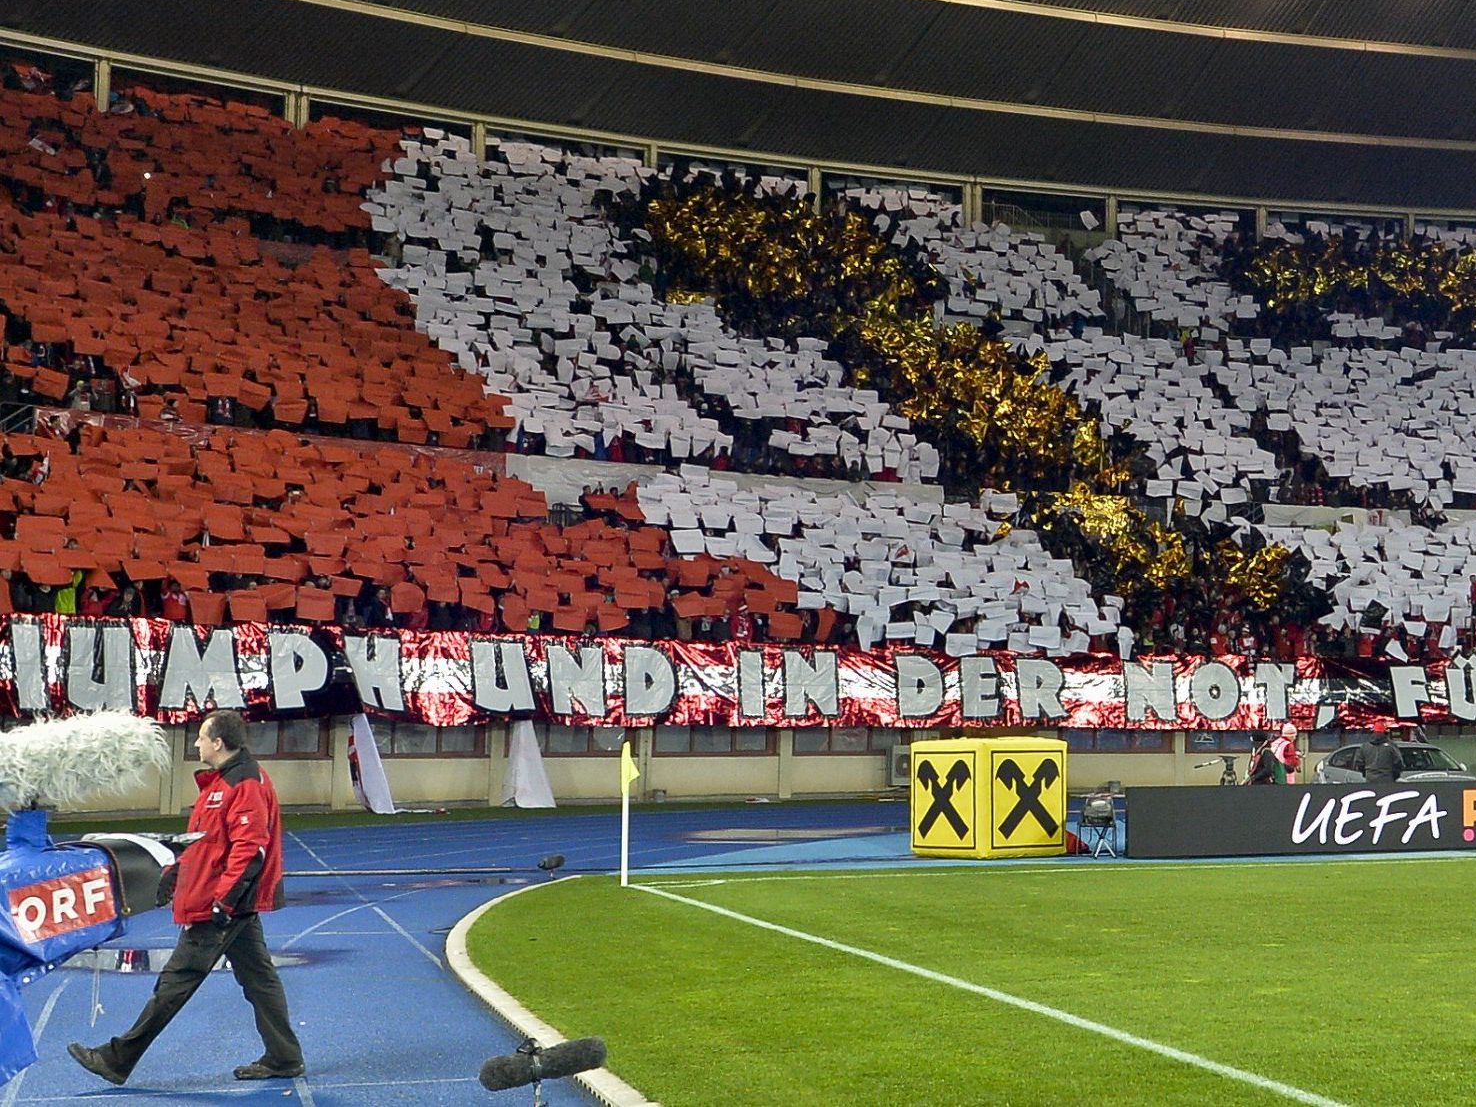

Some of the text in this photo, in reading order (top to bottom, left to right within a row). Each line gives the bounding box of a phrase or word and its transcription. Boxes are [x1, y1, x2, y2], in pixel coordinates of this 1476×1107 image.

[470, 640, 676, 715] UND
[739, 651, 838, 717] IN
[898, 654, 1067, 720] DER
[1125, 660, 1335, 729] NOT,
[1292, 791, 1447, 845] UEFA
[18, 878, 107, 932] ORF
